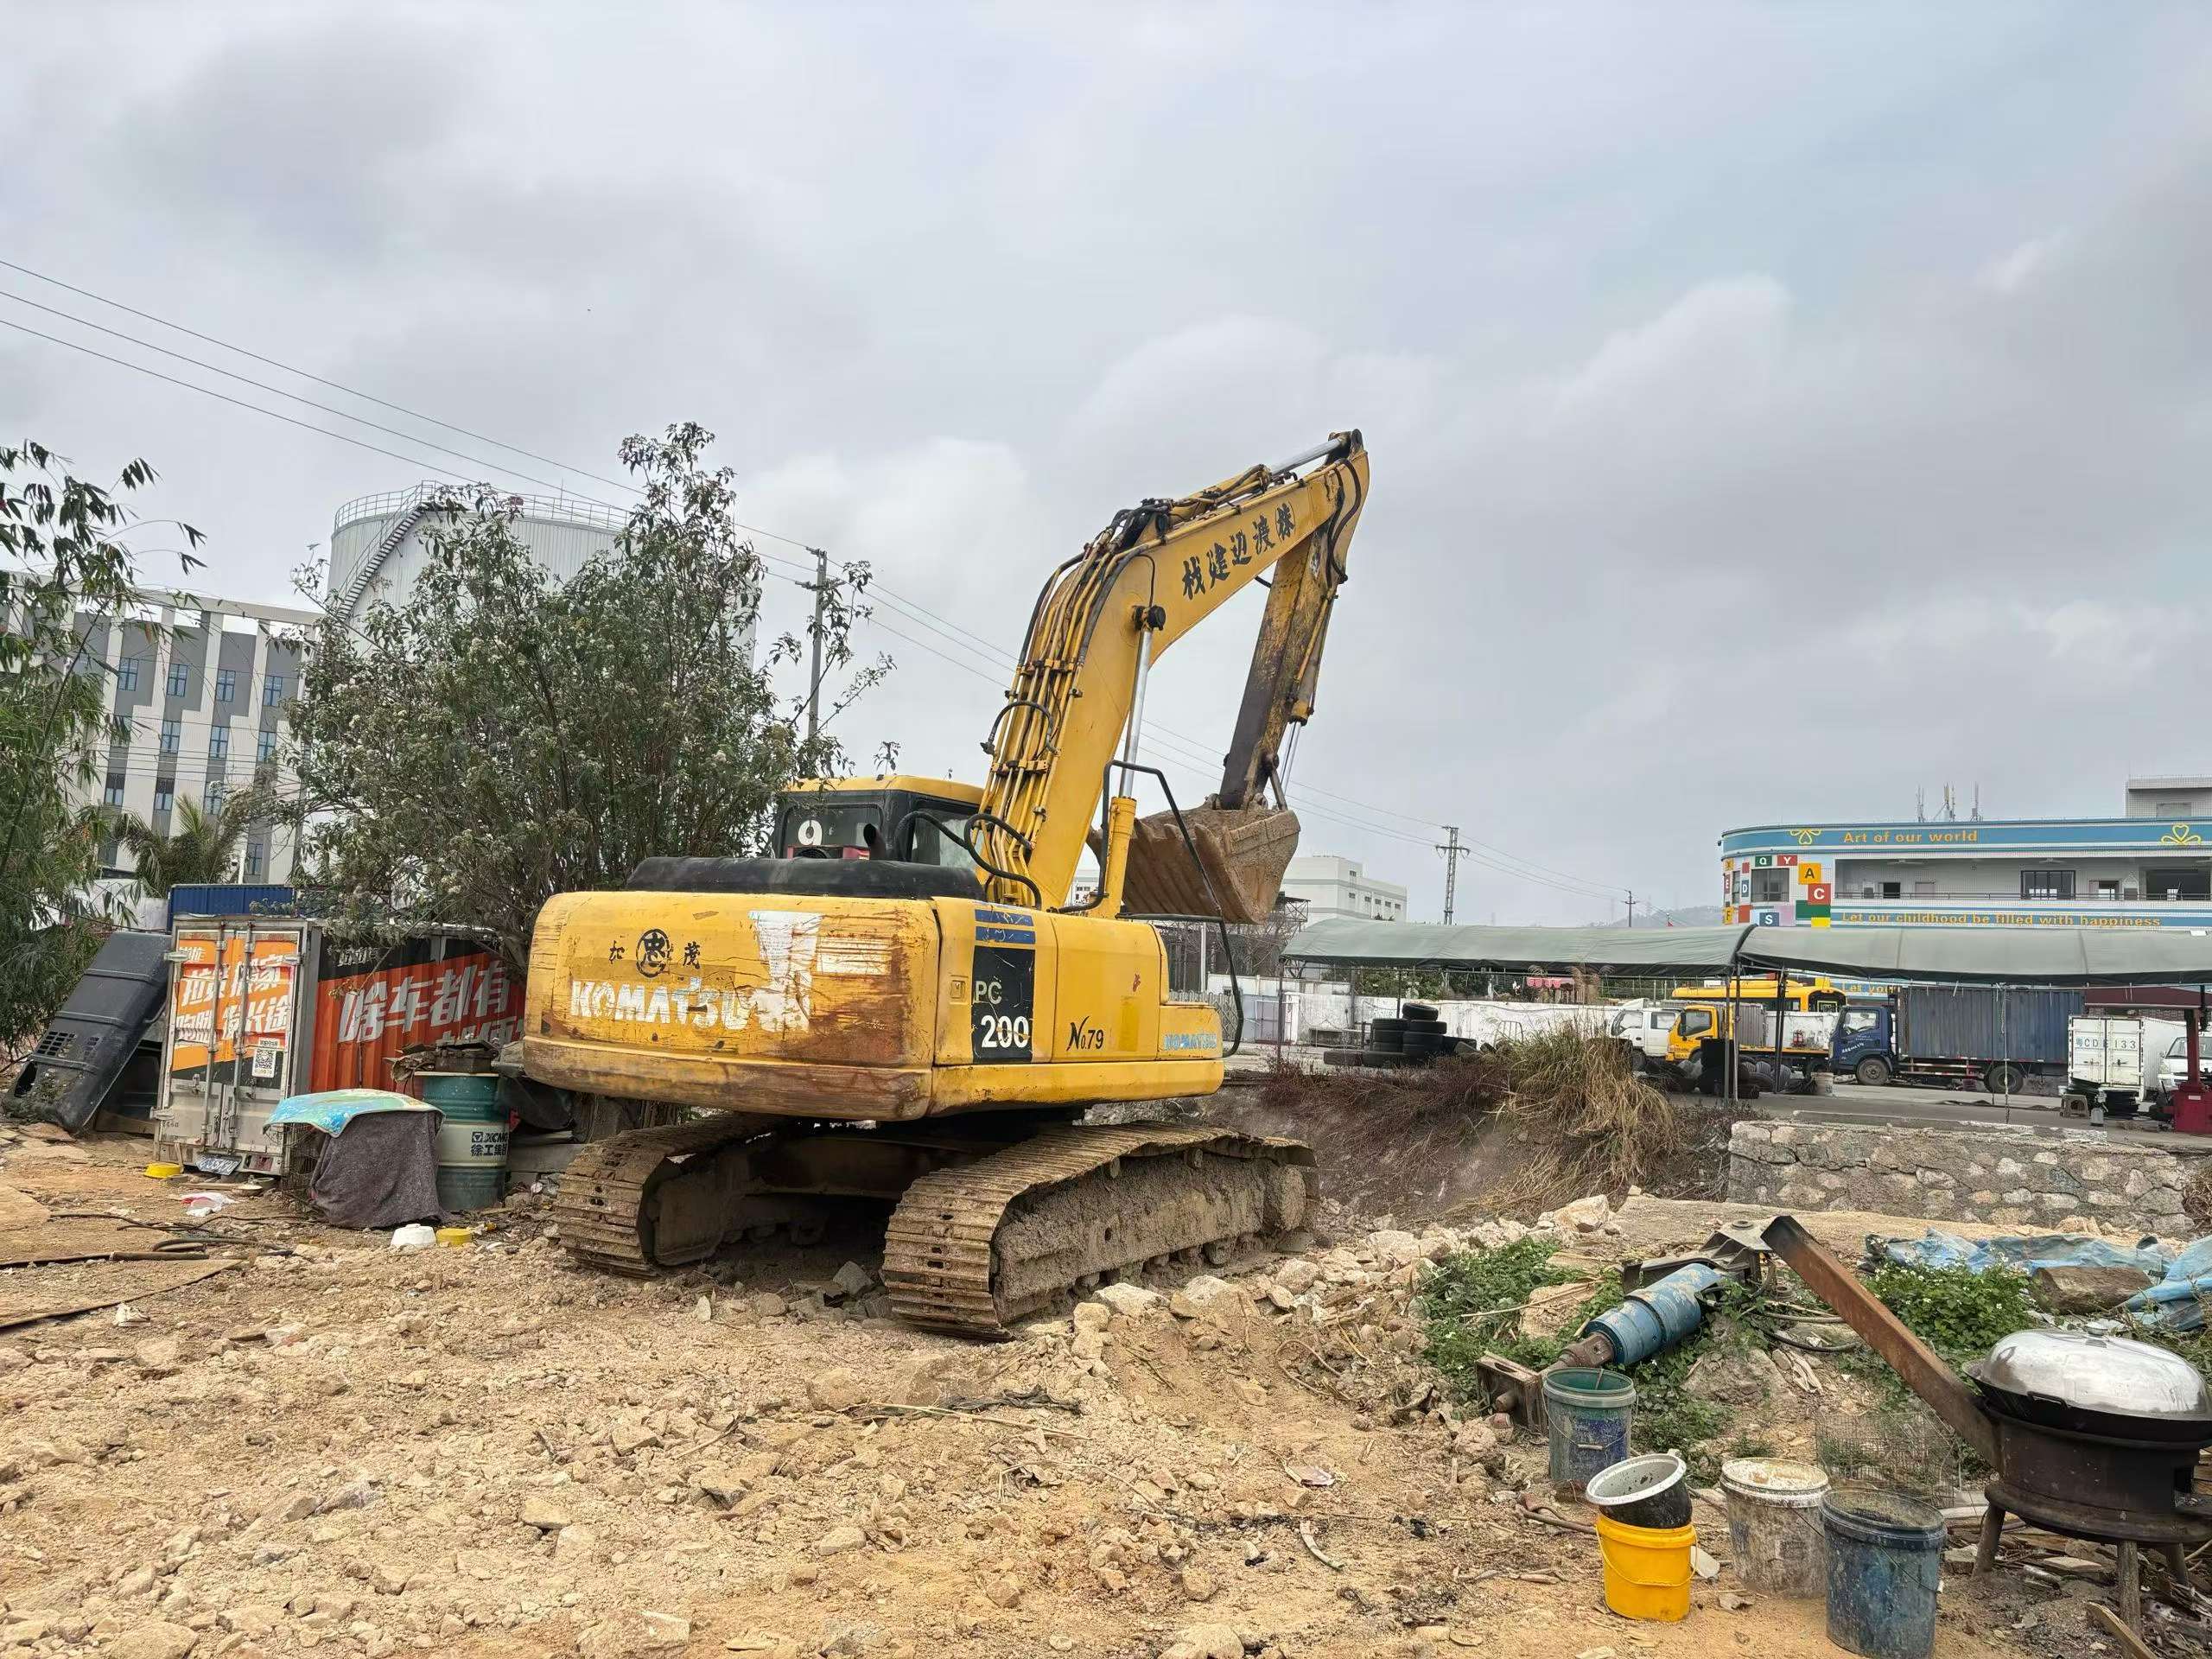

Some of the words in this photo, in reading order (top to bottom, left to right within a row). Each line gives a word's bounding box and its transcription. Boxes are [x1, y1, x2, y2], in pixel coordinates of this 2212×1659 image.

[1843, 832, 1867, 843] Art
[1873, 830, 1890, 843] of
[1895, 835, 1923, 843] our
[1929, 830, 1978, 842] world
[1804, 868, 1815, 879] A
[1742, 884, 1748, 893] D
[1813, 887, 1825, 899] C
[1764, 915, 1773, 925] S
[1842, 912, 1865, 922] Let
[1869, 914, 1890, 923] our
[1896, 912, 1967, 924] childhood
[1973, 913, 1990, 925] be
[1996, 913, 2033, 925] filled
[2040, 915, 2074, 925] with
[2080, 915, 2161, 929] happiness
[975, 980, 1002, 1005] PC
[338, 961, 512, 1043] 啥车都有
[981, 1014, 1029, 1049] 200
